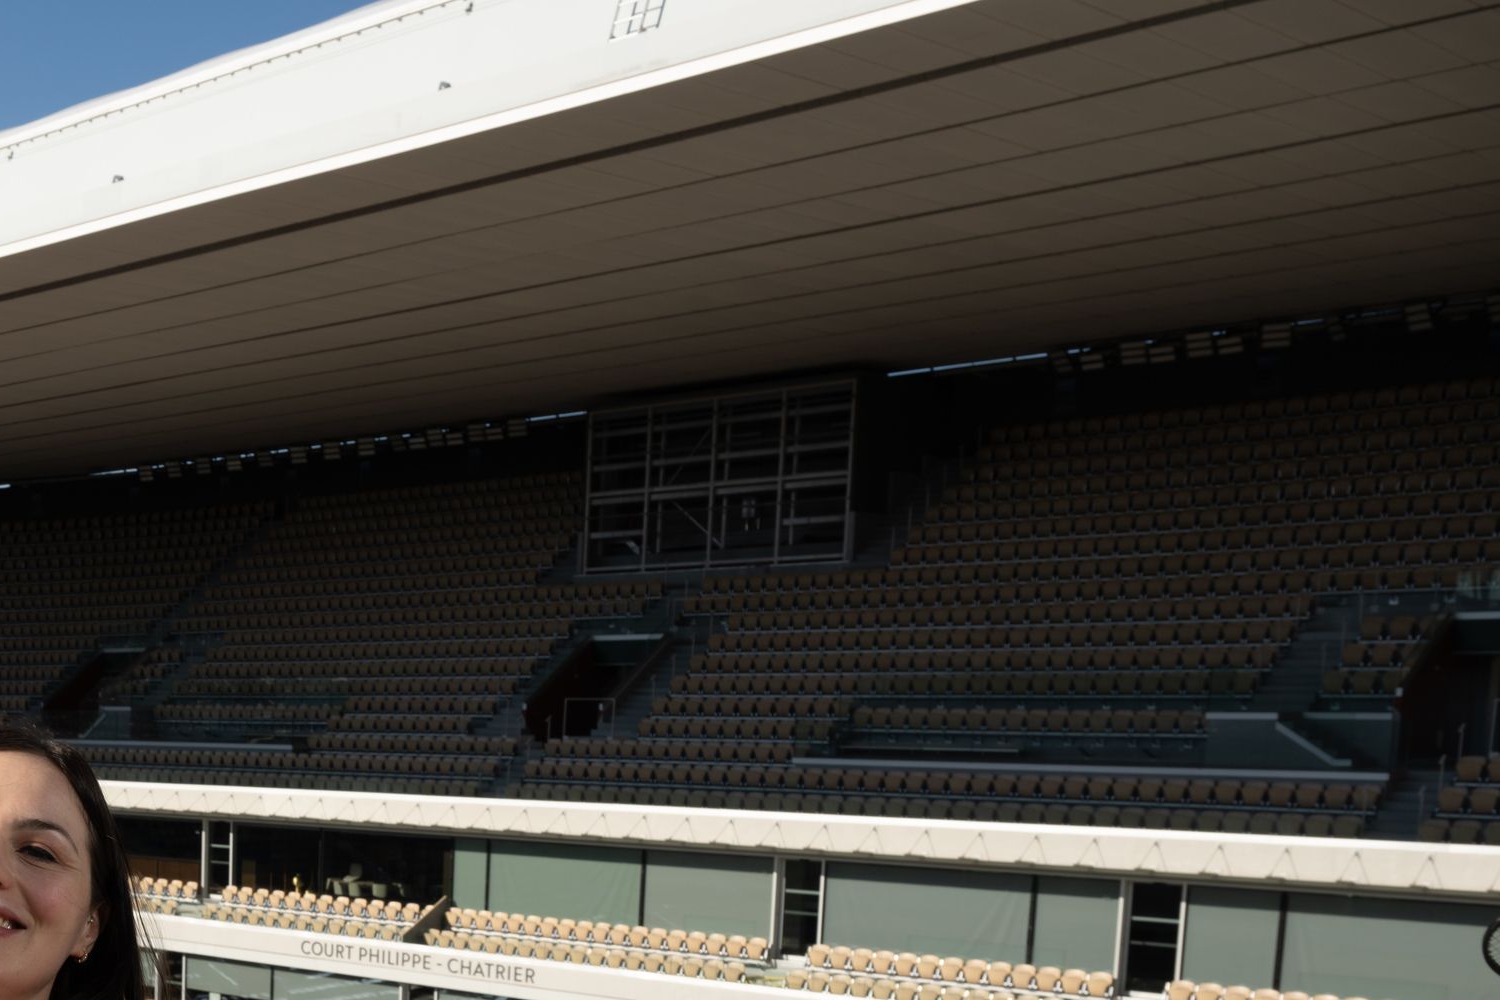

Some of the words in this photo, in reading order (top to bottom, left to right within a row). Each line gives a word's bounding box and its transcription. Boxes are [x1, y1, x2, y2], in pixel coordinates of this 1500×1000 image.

[300, 940, 354, 960] COURT
[359, 946, 431, 970] PHILIPPE
[447, 958, 536, 984] CHATRIER
